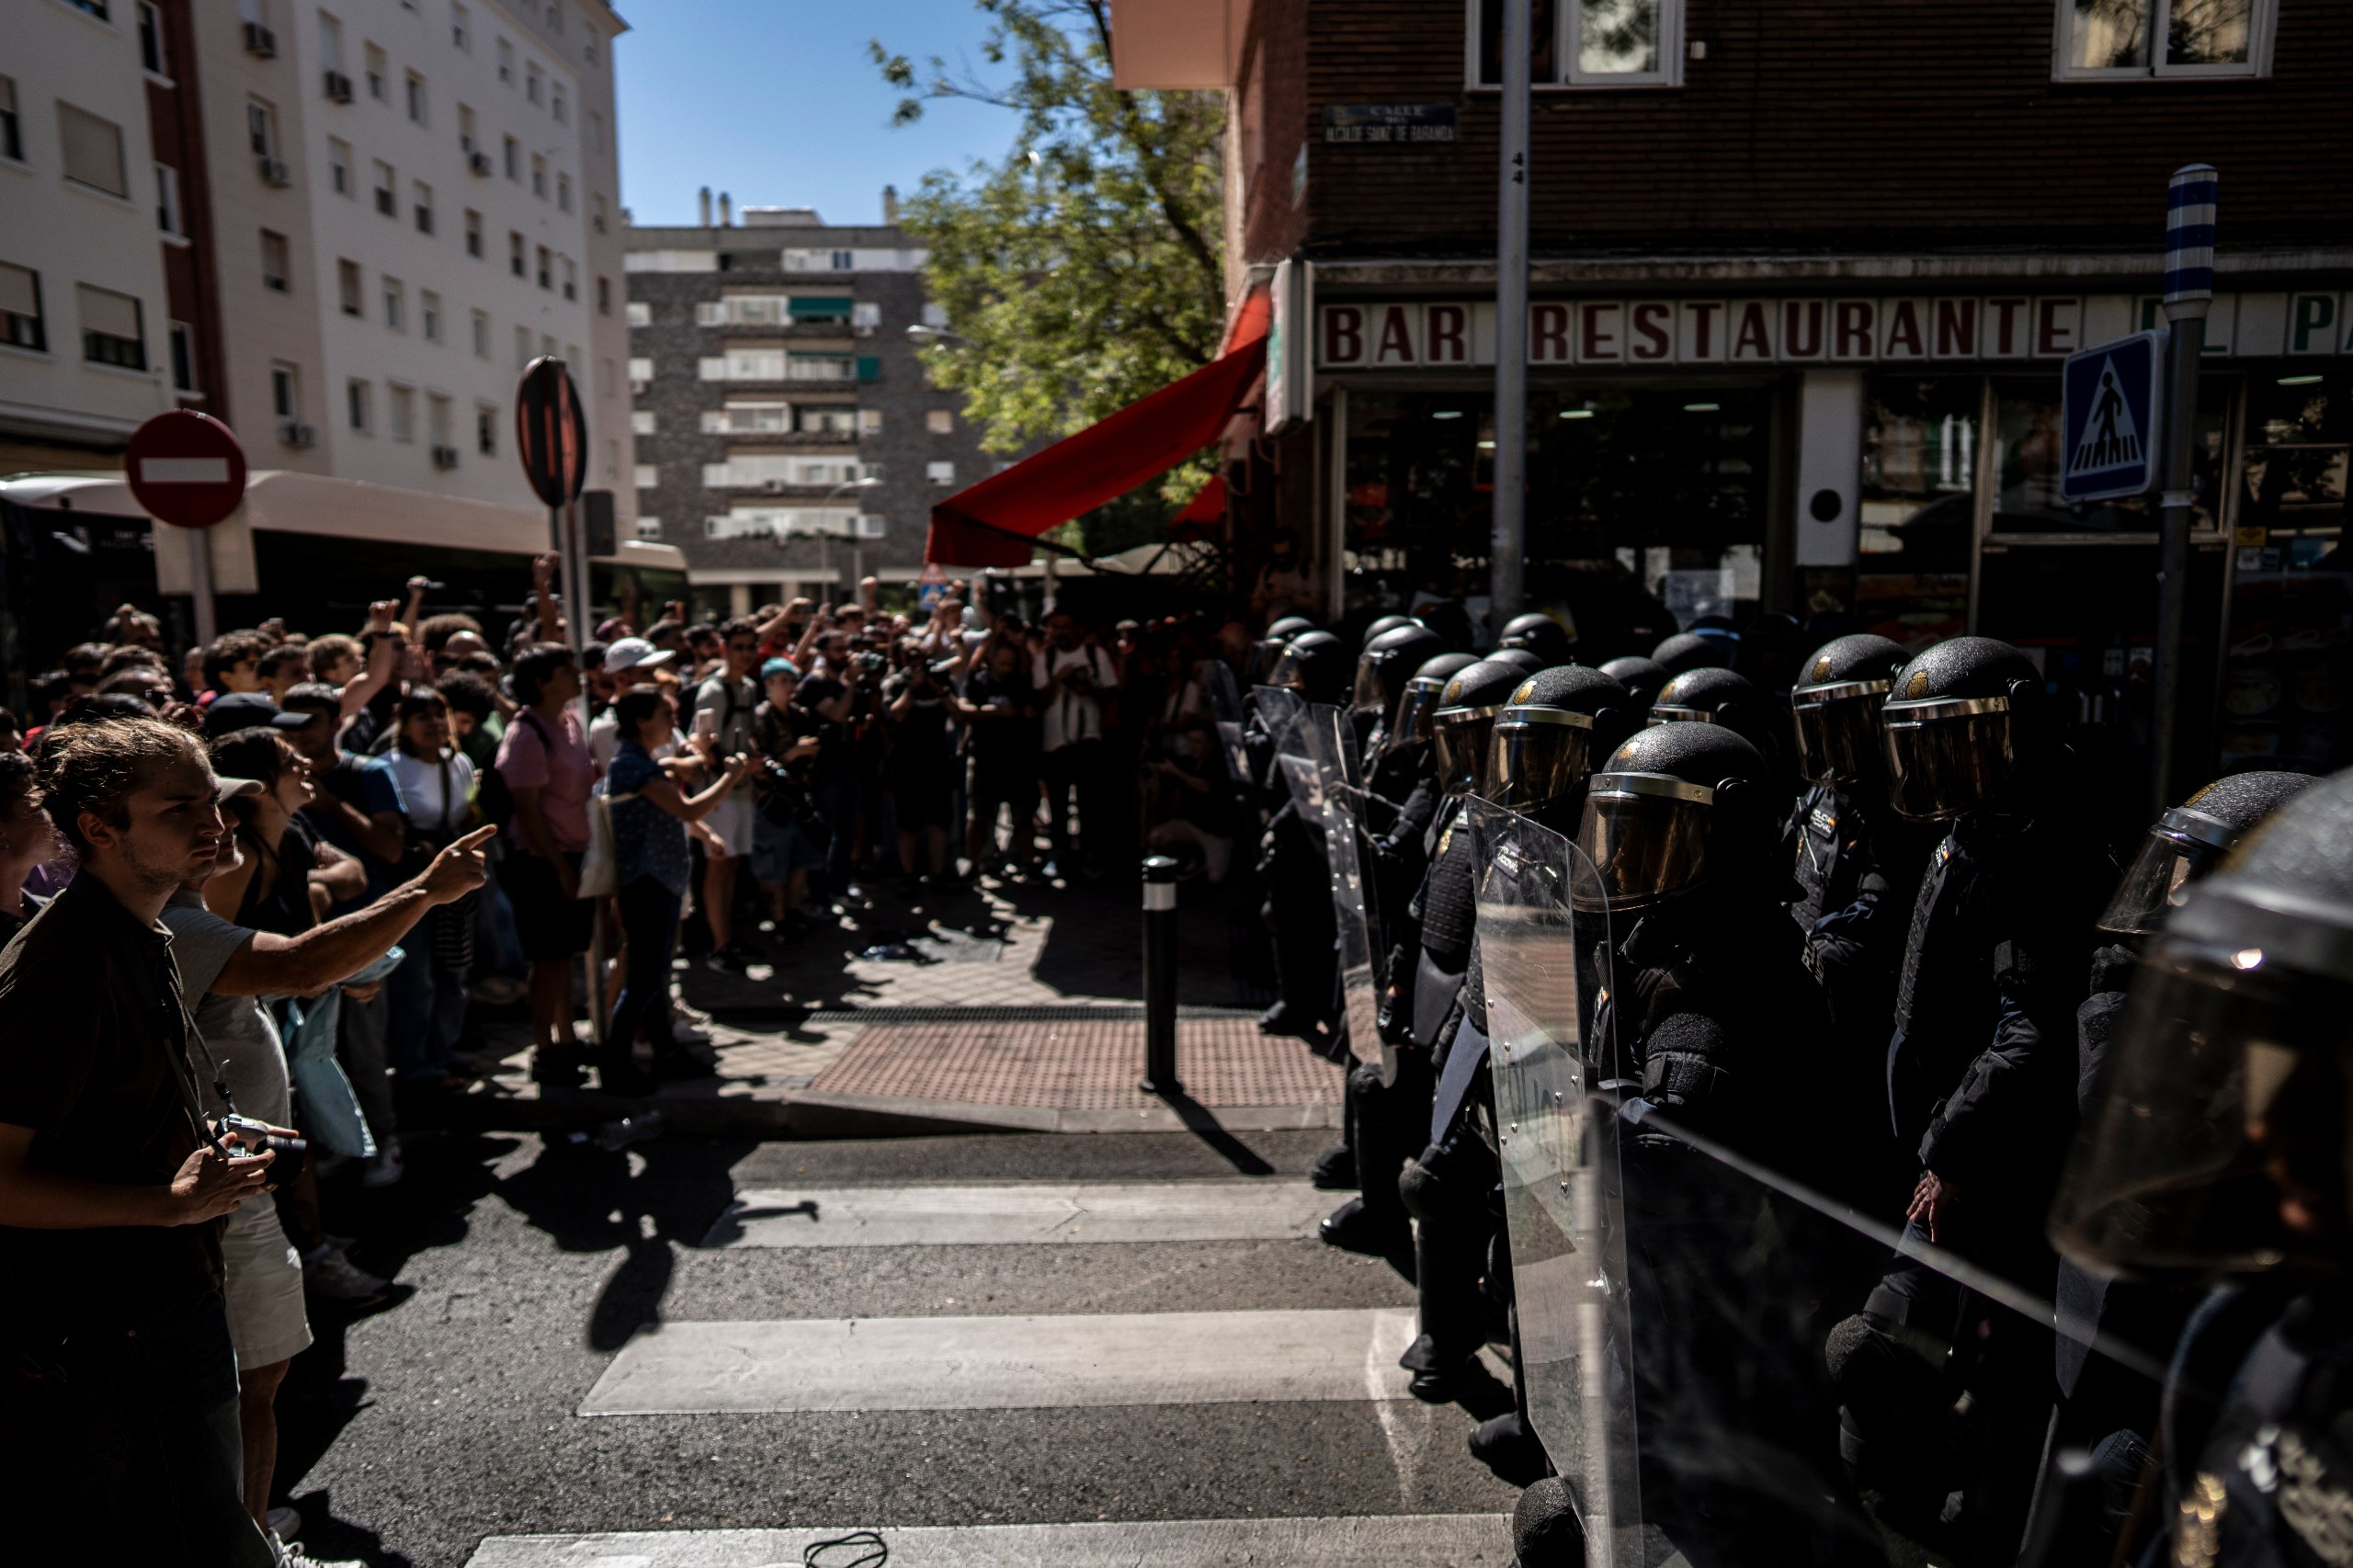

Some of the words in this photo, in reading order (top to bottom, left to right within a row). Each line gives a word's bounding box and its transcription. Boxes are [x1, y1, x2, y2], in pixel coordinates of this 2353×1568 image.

[1369, 104, 1425, 116] CALLE
[1395, 125, 1408, 142] DE
[1326, 305, 1464, 363] BAR
[1531, 299, 2077, 361] RESTAURANTE
[2291, 294, 2353, 352] P
